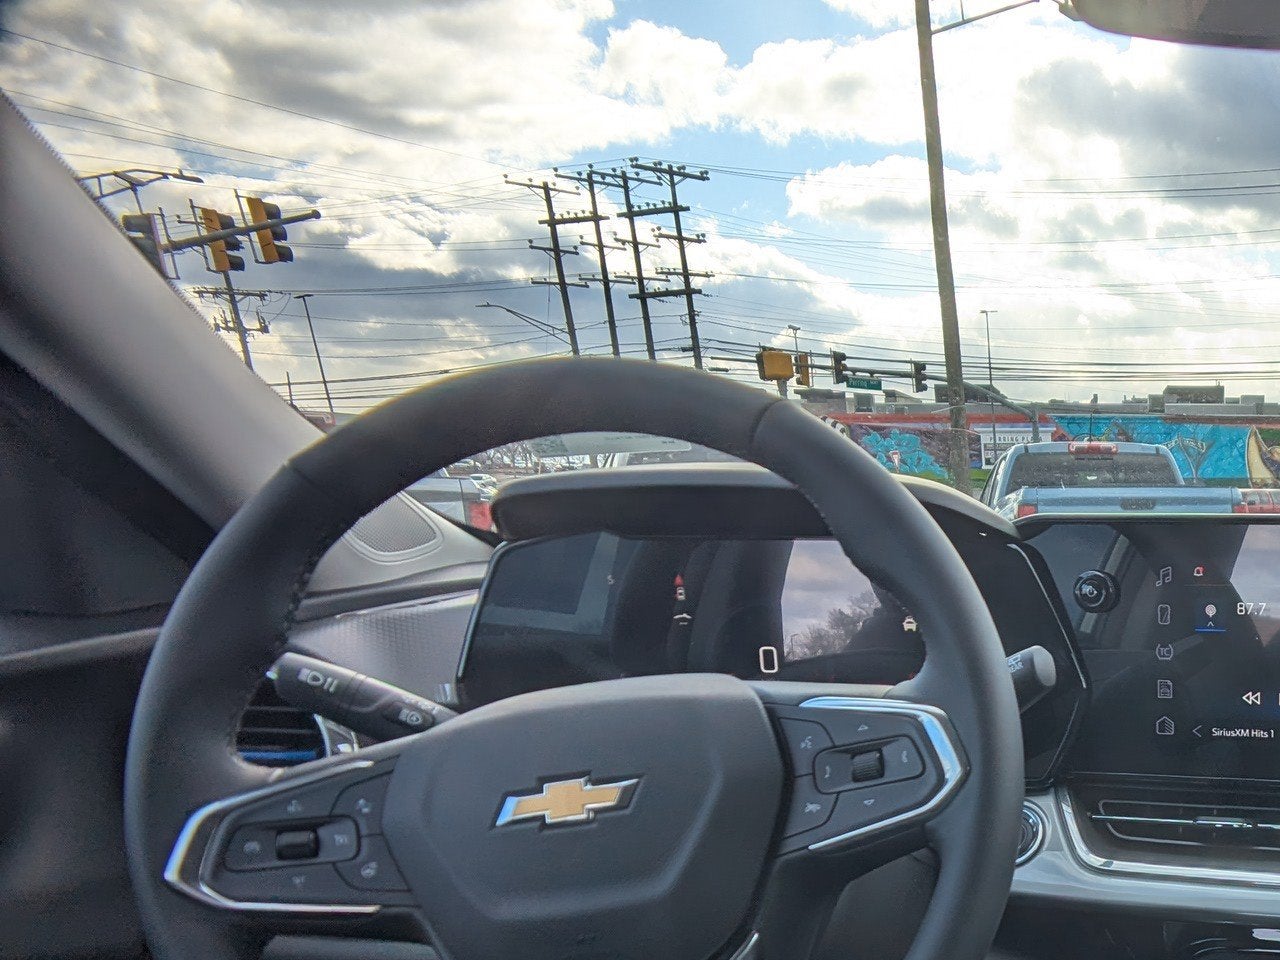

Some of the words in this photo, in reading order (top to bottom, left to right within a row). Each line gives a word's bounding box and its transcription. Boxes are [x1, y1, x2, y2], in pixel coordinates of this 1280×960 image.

[1236, 602, 1267, 615] 87.7
[1211, 727, 1250, 737] SiriusXM
[1251, 729, 1268, 738] Hits
